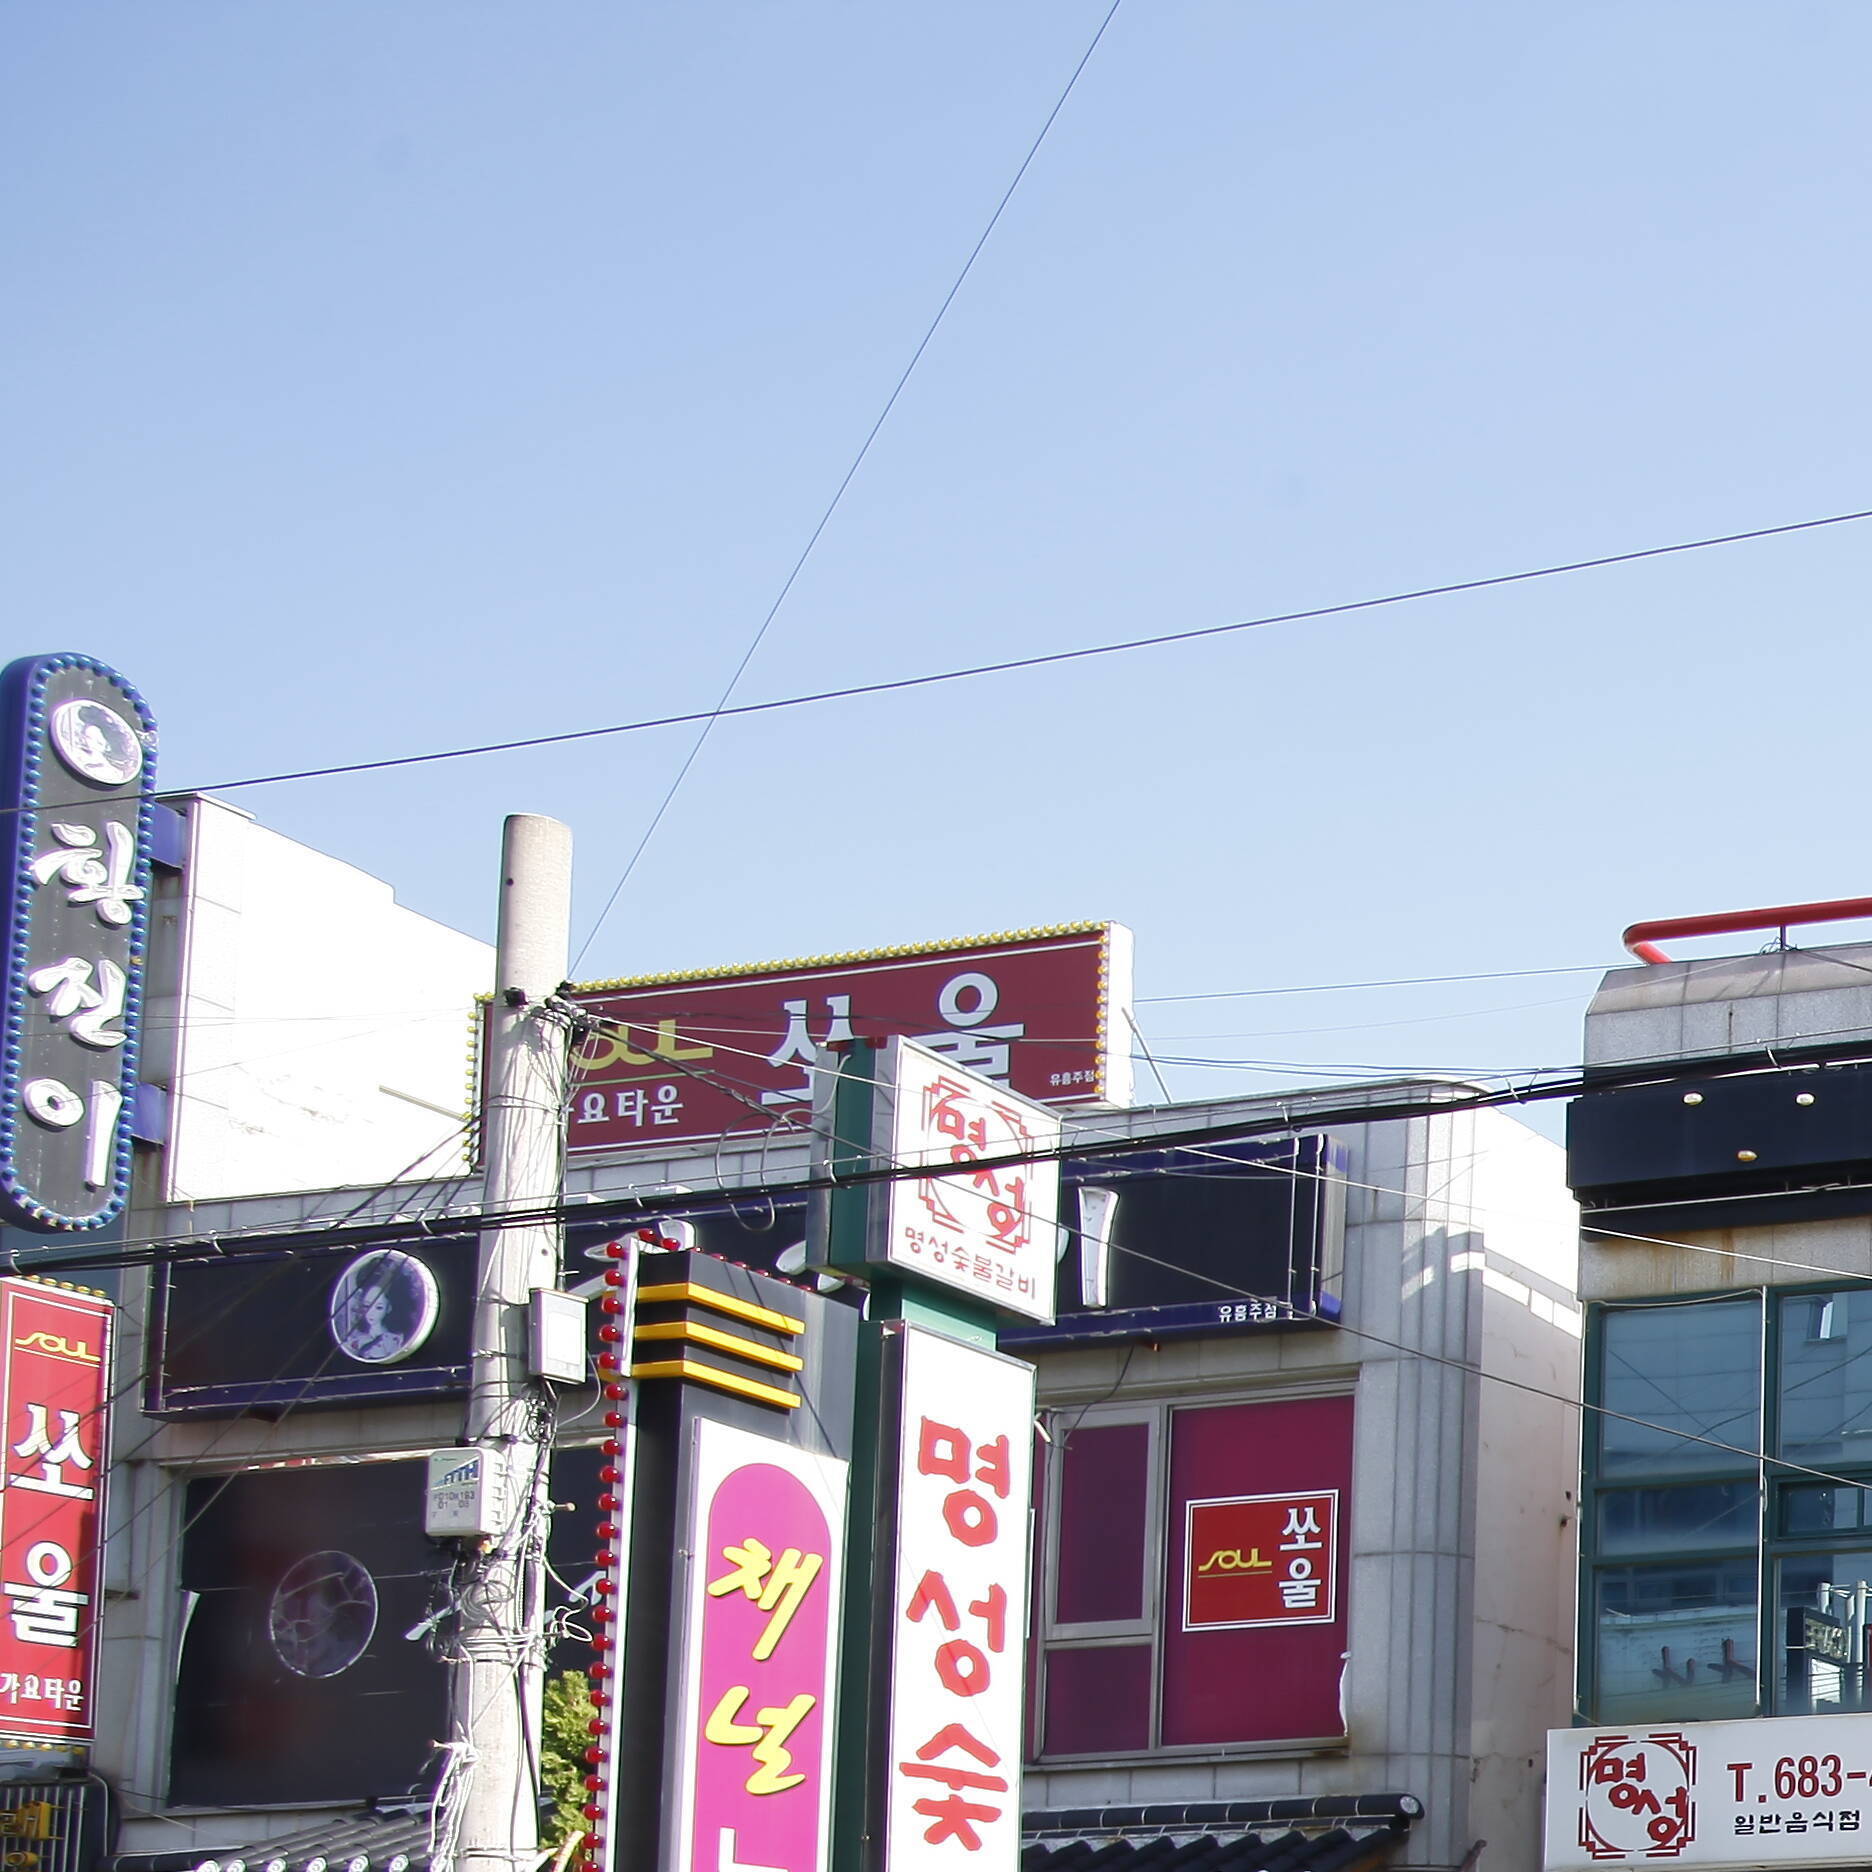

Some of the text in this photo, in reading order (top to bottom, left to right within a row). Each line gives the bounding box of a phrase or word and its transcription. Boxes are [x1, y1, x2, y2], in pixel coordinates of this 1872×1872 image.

[25, 821, 144, 1189] 황진이
[562, 1084, 684, 1127] 요타운
[1049, 1070, 1095, 1087] 유흥주점
[905, 1227, 1036, 1300] 명성숯불갈비
[1218, 1302, 1278, 1322] 유흥주점
[4, 1402, 95, 1648] 쏘울
[1278, 1507, 1324, 1610] 쏘울
[0, 1673, 85, 1712] 가요타운
[705, 1537, 824, 1796] 채널
[1595, 1751, 1690, 1848] 명성
[1734, 1810, 1862, 1836] 일반음식점
